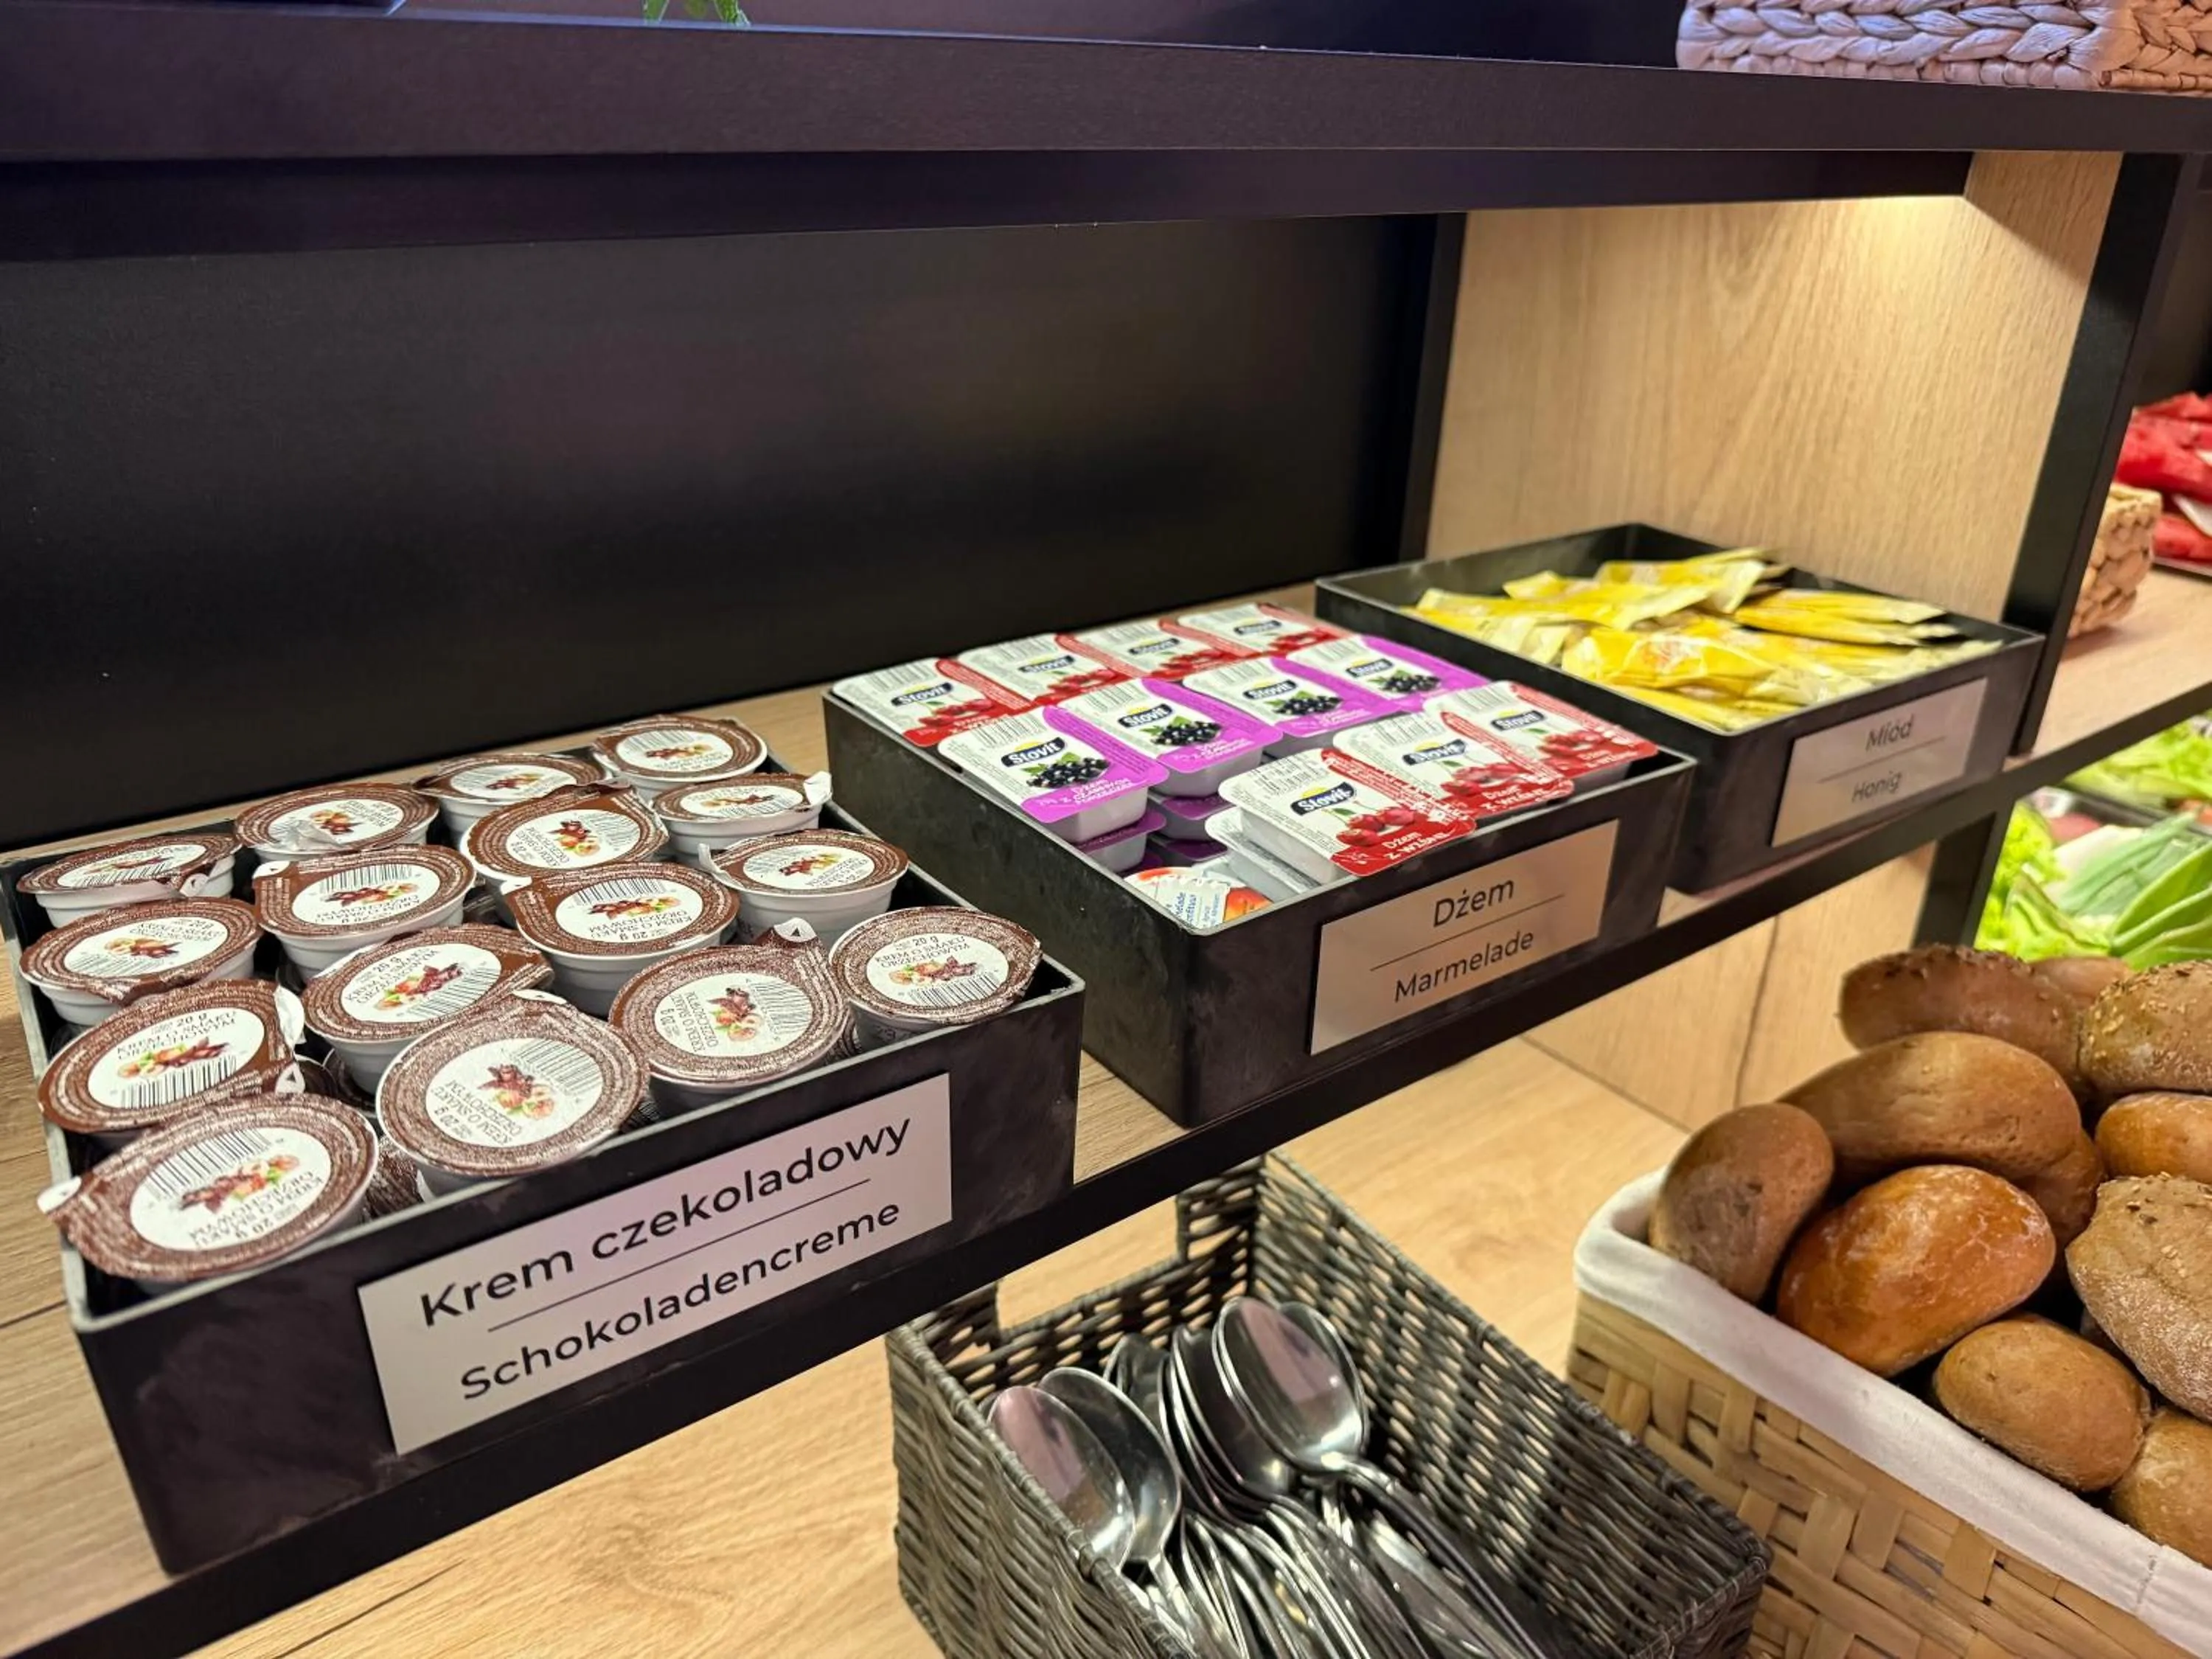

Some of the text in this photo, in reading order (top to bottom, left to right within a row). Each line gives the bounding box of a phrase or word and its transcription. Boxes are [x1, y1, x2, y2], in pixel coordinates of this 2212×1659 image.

[1123, 706, 1169, 727] Stovit
[1008, 740, 1061, 765] Stovit
[1298, 787, 1352, 811] Stovit
[1852, 771, 1902, 804] Honig
[1433, 879, 1514, 928] Dżem
[912, 938, 927, 946] 20
[1394, 931, 1534, 1003] Marmelade
[177, 1015, 193, 1027] 20
[251, 1219, 274, 1234] 20
[420, 1118, 911, 1327] Krem czekoladowy
[460, 1203, 900, 1399] Schokoladencreme
